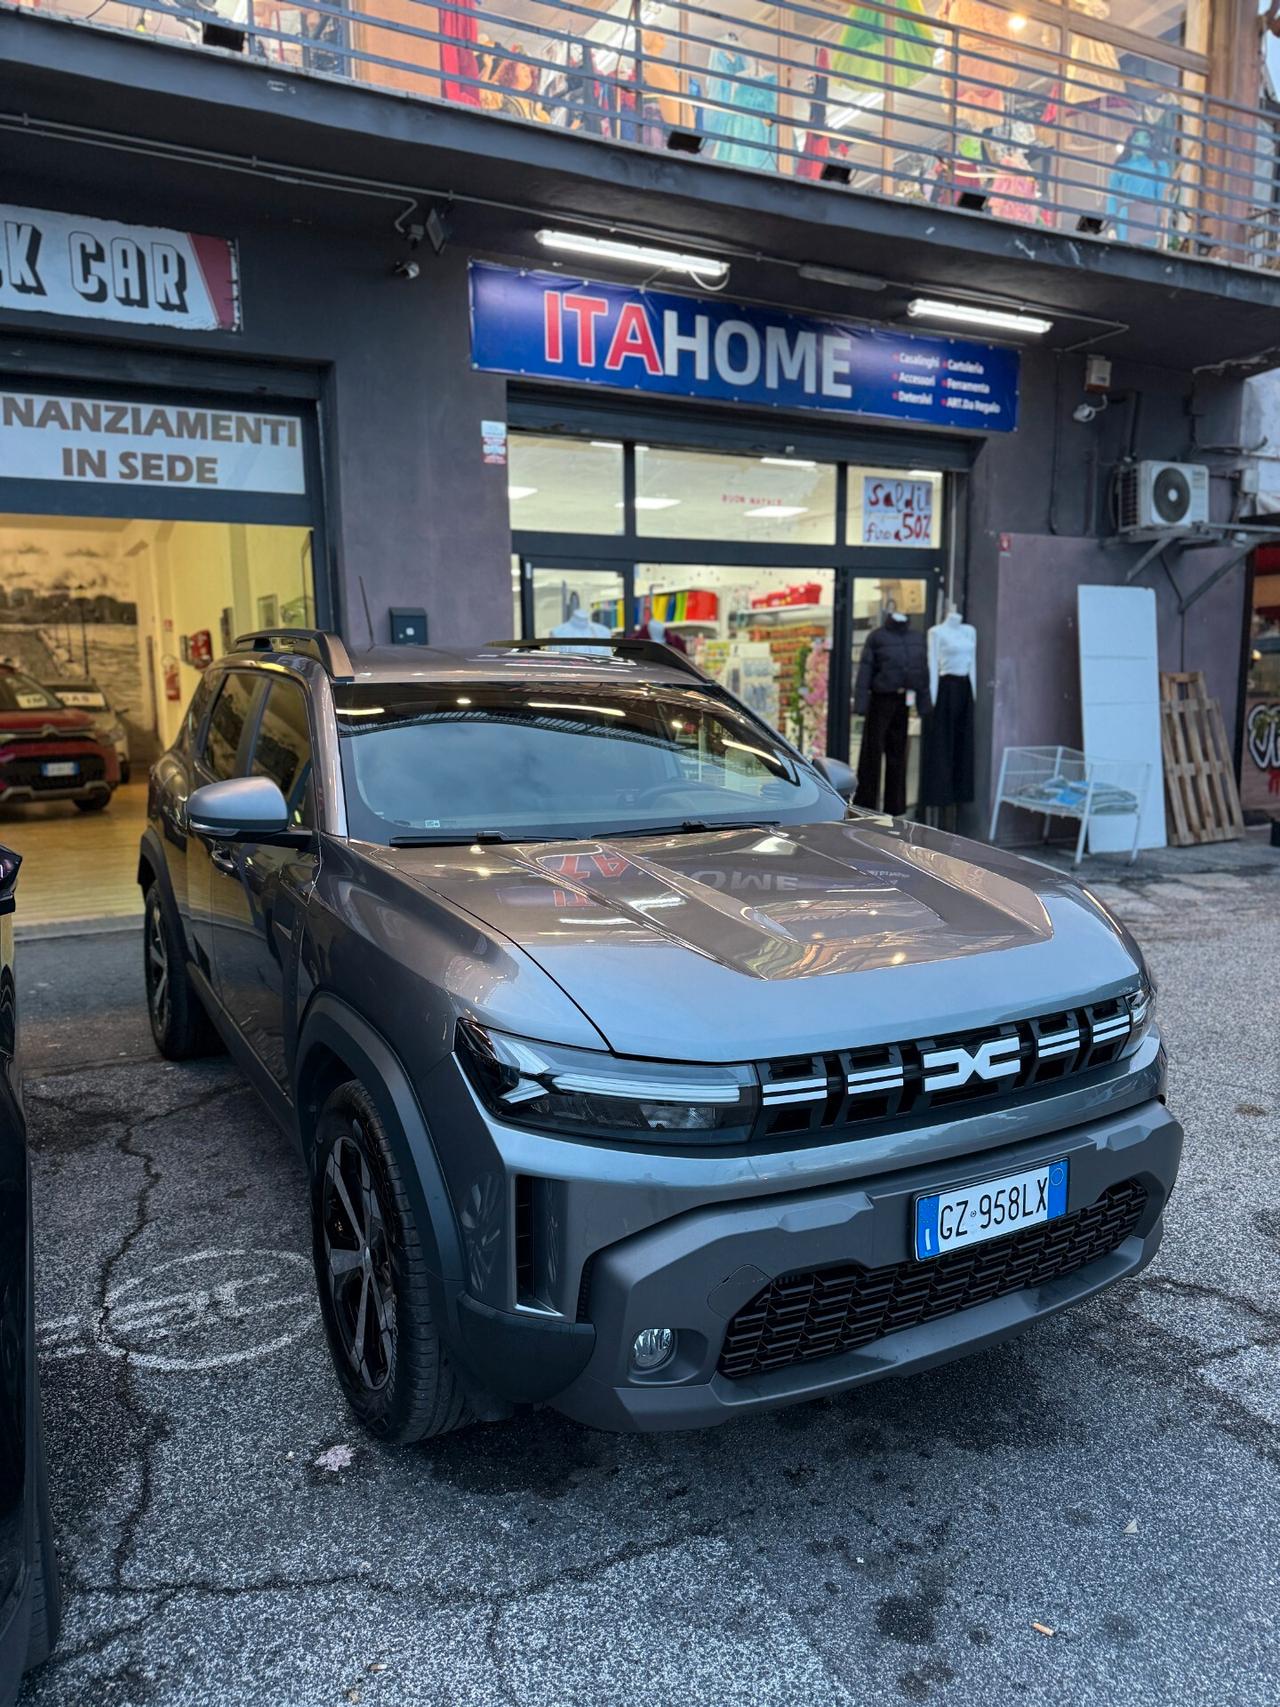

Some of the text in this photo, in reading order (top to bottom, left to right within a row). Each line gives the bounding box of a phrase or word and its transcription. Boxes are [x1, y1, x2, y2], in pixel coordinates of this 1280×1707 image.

[0, 221, 189, 314] K CAR
[899, 352, 940, 370] Casalinghi
[948, 359, 984, 375] Cartoleria
[947, 378, 991, 394] Ferramenta
[2, 396, 298, 448] NANZIAMENTI
[62, 447, 219, 485] IN SEDE
